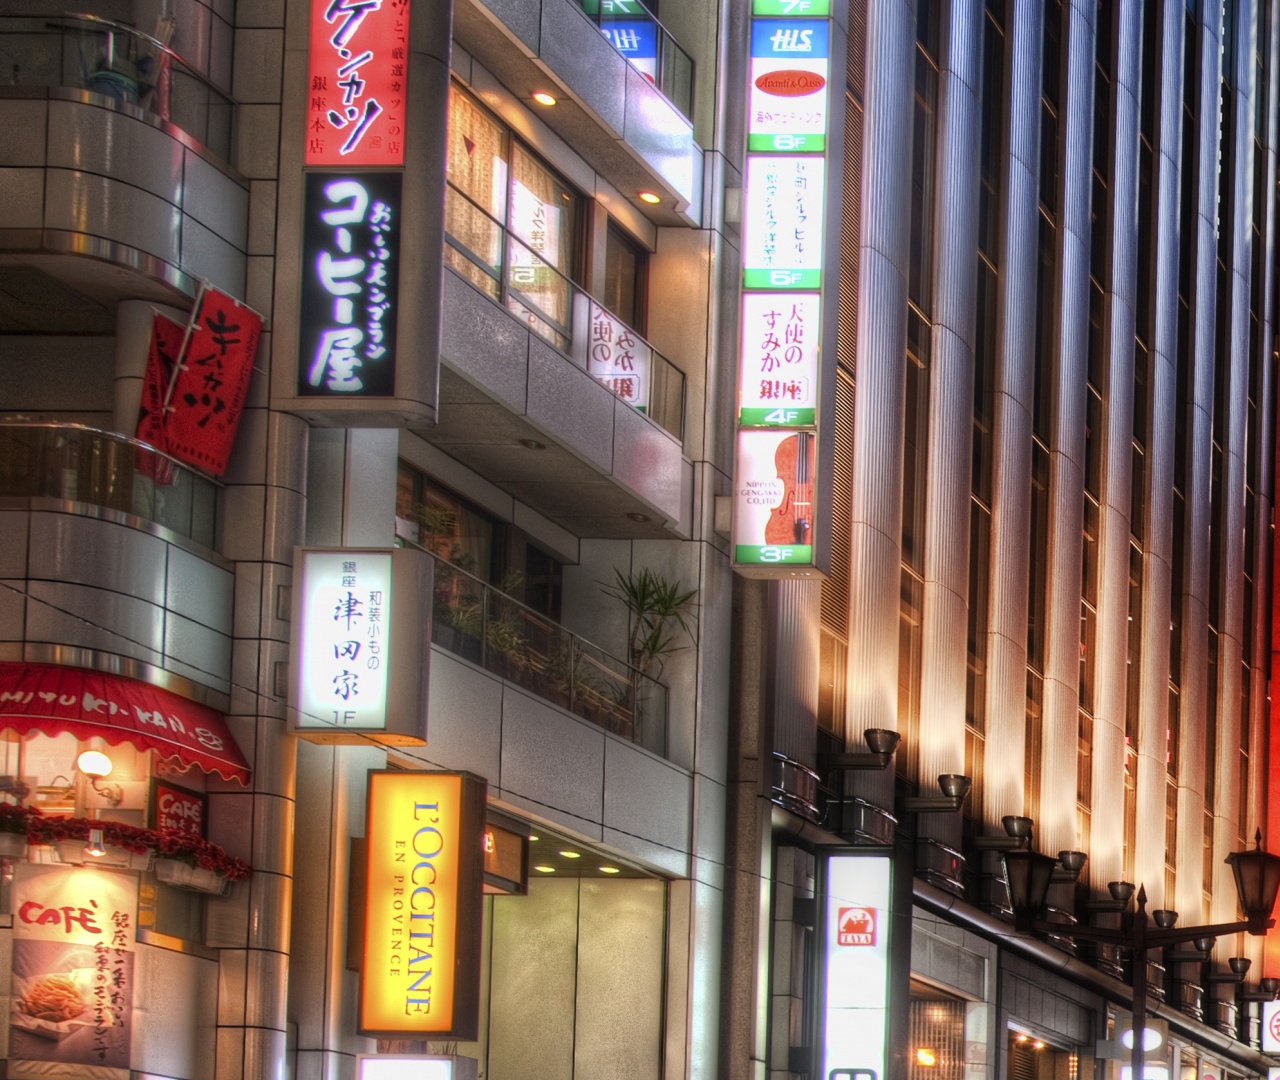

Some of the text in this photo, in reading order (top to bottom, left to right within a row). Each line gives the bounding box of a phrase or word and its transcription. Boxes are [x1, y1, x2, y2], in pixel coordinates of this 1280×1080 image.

[309, 76, 328, 155] 銀座本店
[774, 135, 806, 150] 6F
[309, 180, 367, 392] コーヒー屋
[770, 270, 803, 286] 5F
[761, 310, 781, 373] すみか
[784, 302, 804, 365] 天使の
[759, 379, 802, 401] 銀座
[765, 408, 798, 424] 4F
[760, 546, 793, 562] 3F
[342, 561, 357, 587] 銀座
[367, 590, 382, 670] 和装小もの
[332, 710, 357, 725] 1F
[389, 840, 406, 977] EN PROVENCE
[405, 801, 444, 1016] L'OCCITANE
[842, 933, 872, 944] TAYA
